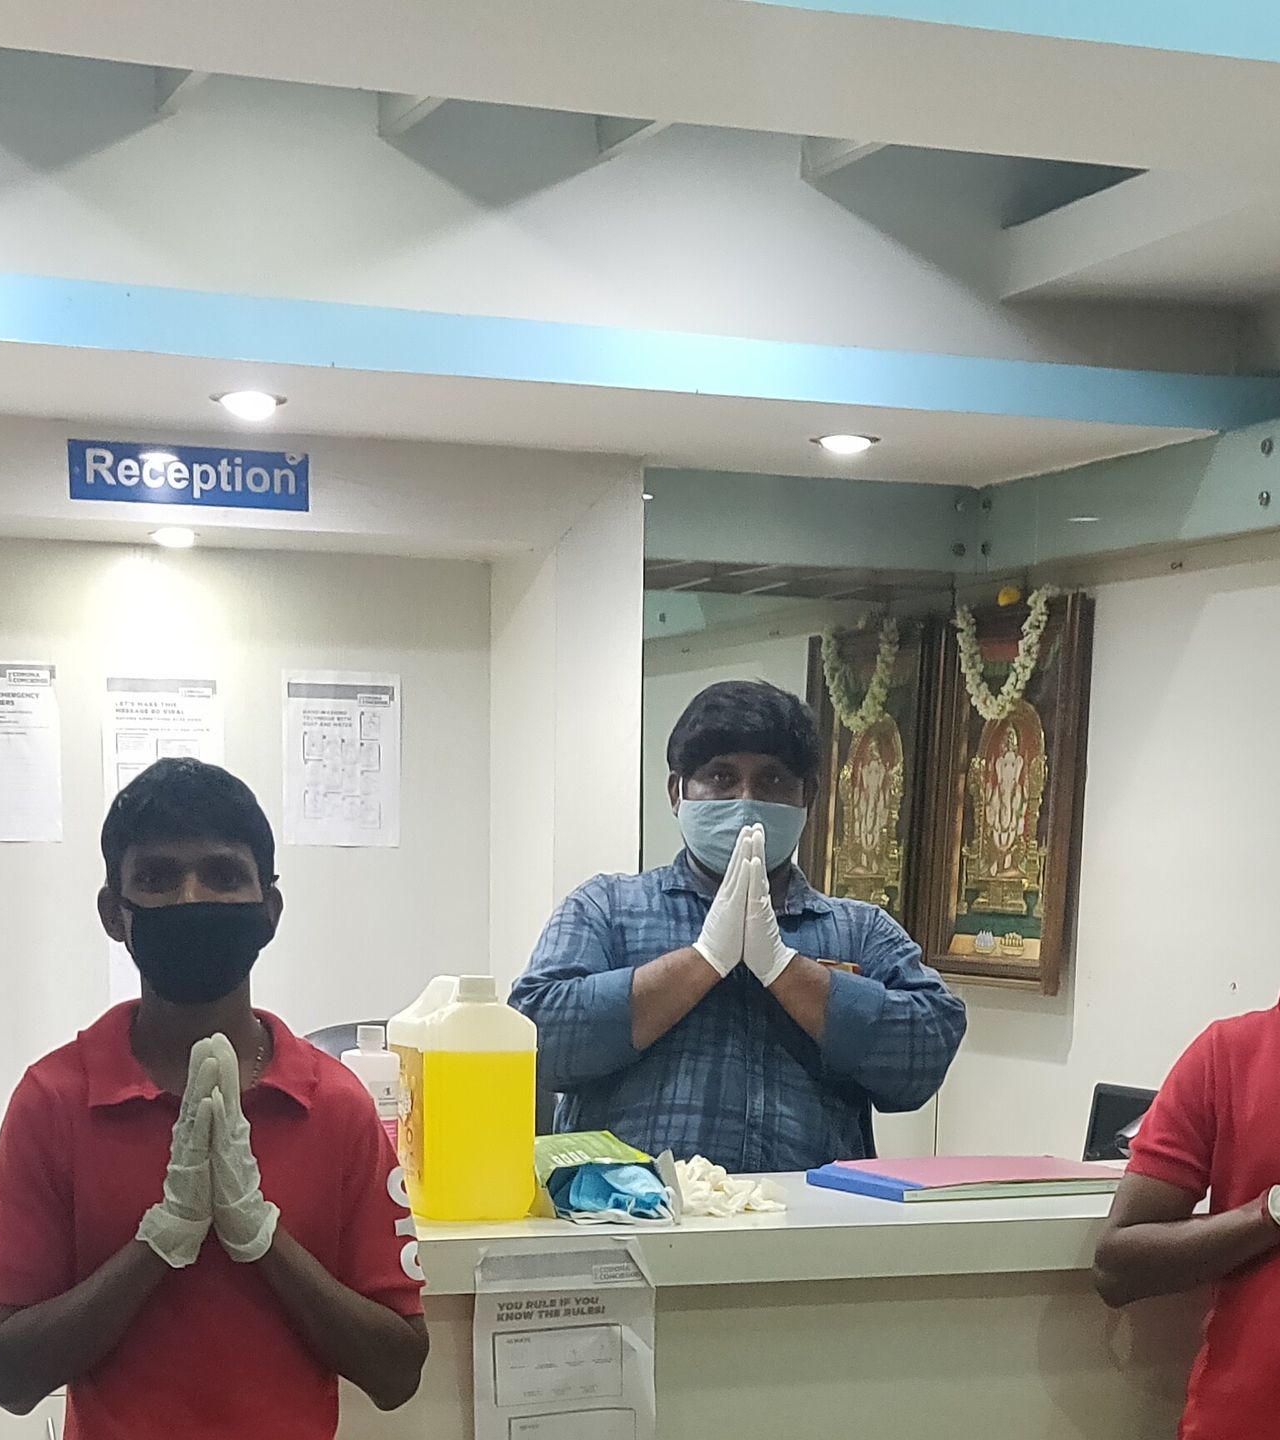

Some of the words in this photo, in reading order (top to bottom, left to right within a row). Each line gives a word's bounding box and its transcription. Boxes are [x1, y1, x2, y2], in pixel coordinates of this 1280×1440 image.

[84, 447, 297, 499] Reception
[496, 1301, 522, 1312] YOU
[525, 1298, 557, 1310] RULE
[559, 1297, 572, 1306] IF
[574, 1296, 599, 1305] YOU
[496, 1310, 534, 1322] KNOW
[537, 1309, 561, 1319] THE
[562, 1305, 606, 1317] RULES!
